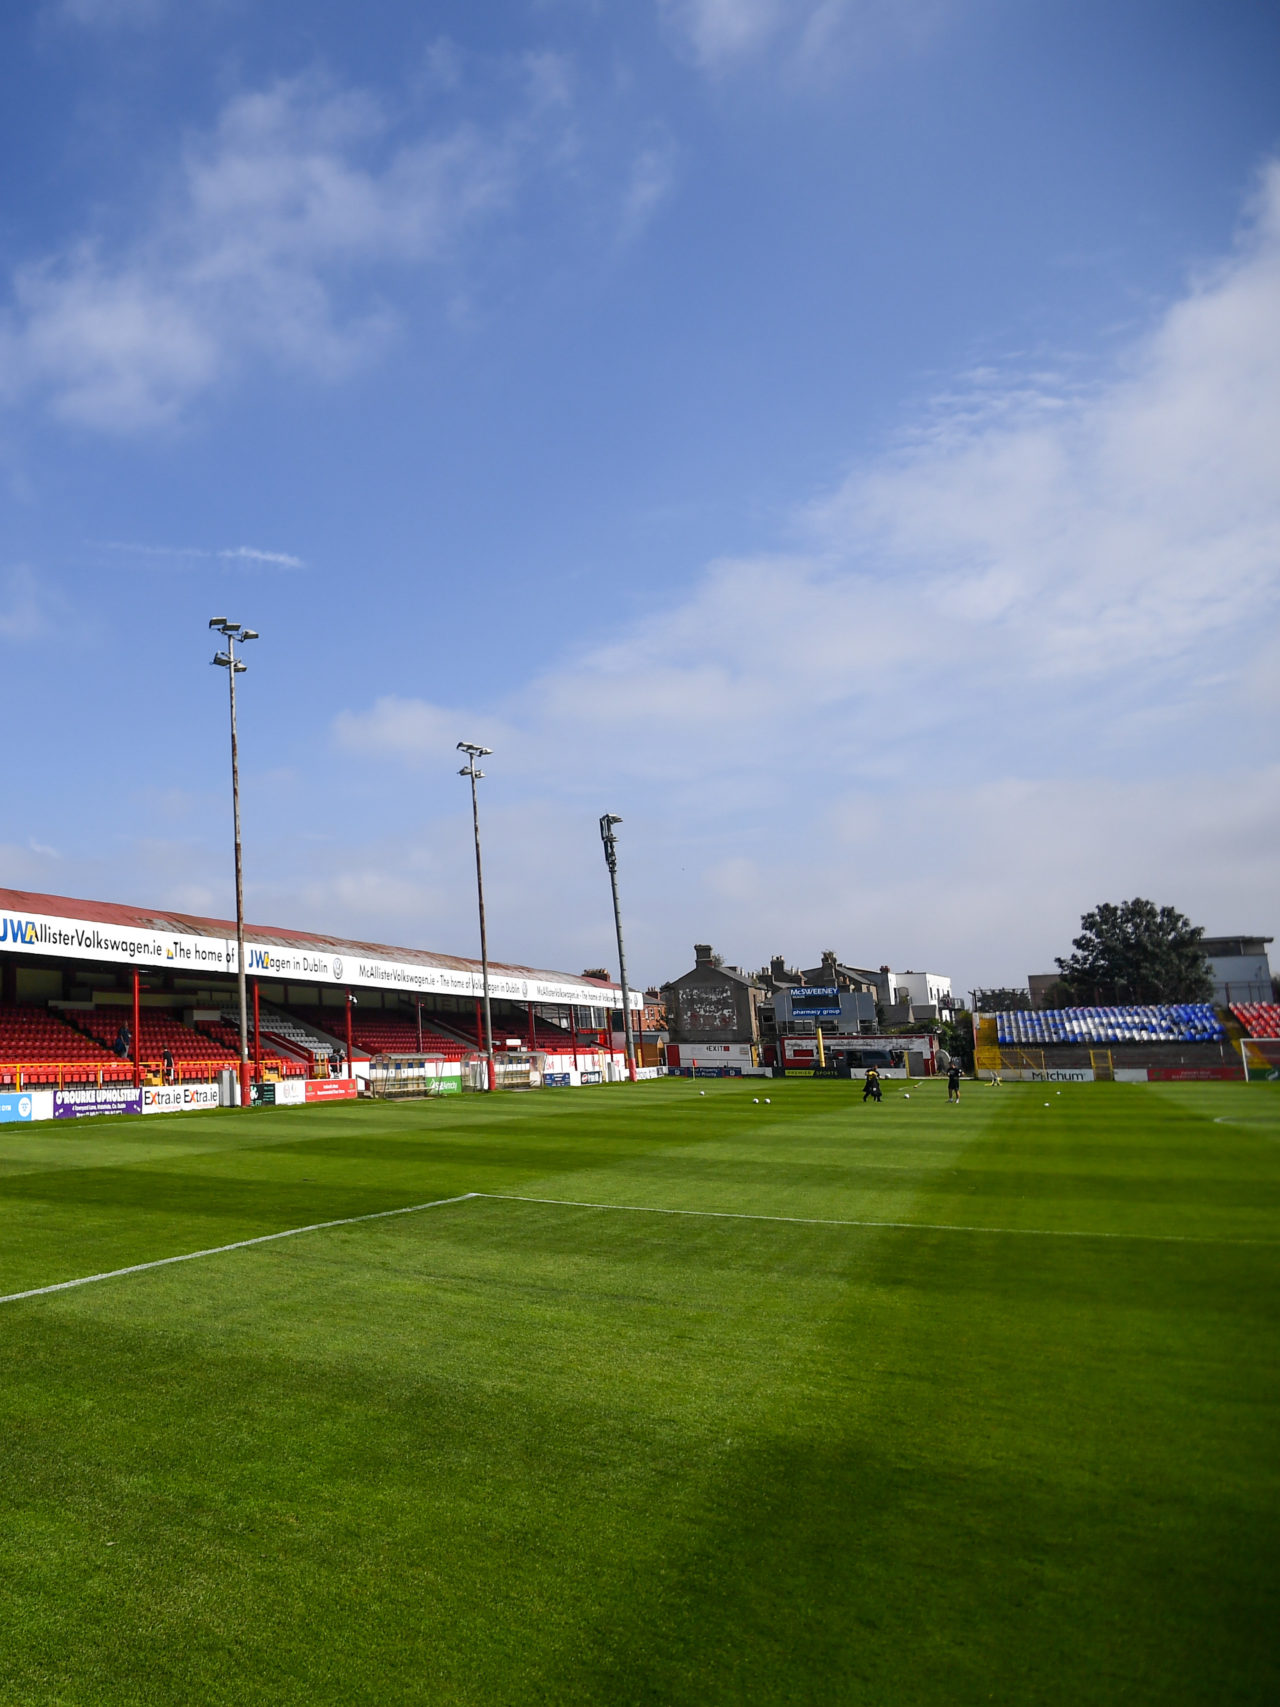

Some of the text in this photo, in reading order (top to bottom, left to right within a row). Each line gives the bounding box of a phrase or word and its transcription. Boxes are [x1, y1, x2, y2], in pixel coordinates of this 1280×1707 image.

[173, 941, 191, 959] The
[195, 943, 222, 962] home
[226, 947, 235, 963] of
[293, 956, 301, 970] in
[303, 957, 329, 973] Dublin
[440, 974, 450, 985] The
[451, 976, 465, 989] home
[791, 987, 838, 996] McSWEENEY
[1032, 1071, 1084, 1081] Mtchum
[56, 1089, 140, 1105] O'ROURKE UPHOLSTERY
[144, 1088, 217, 1106] Extra.ie Extra.ie
